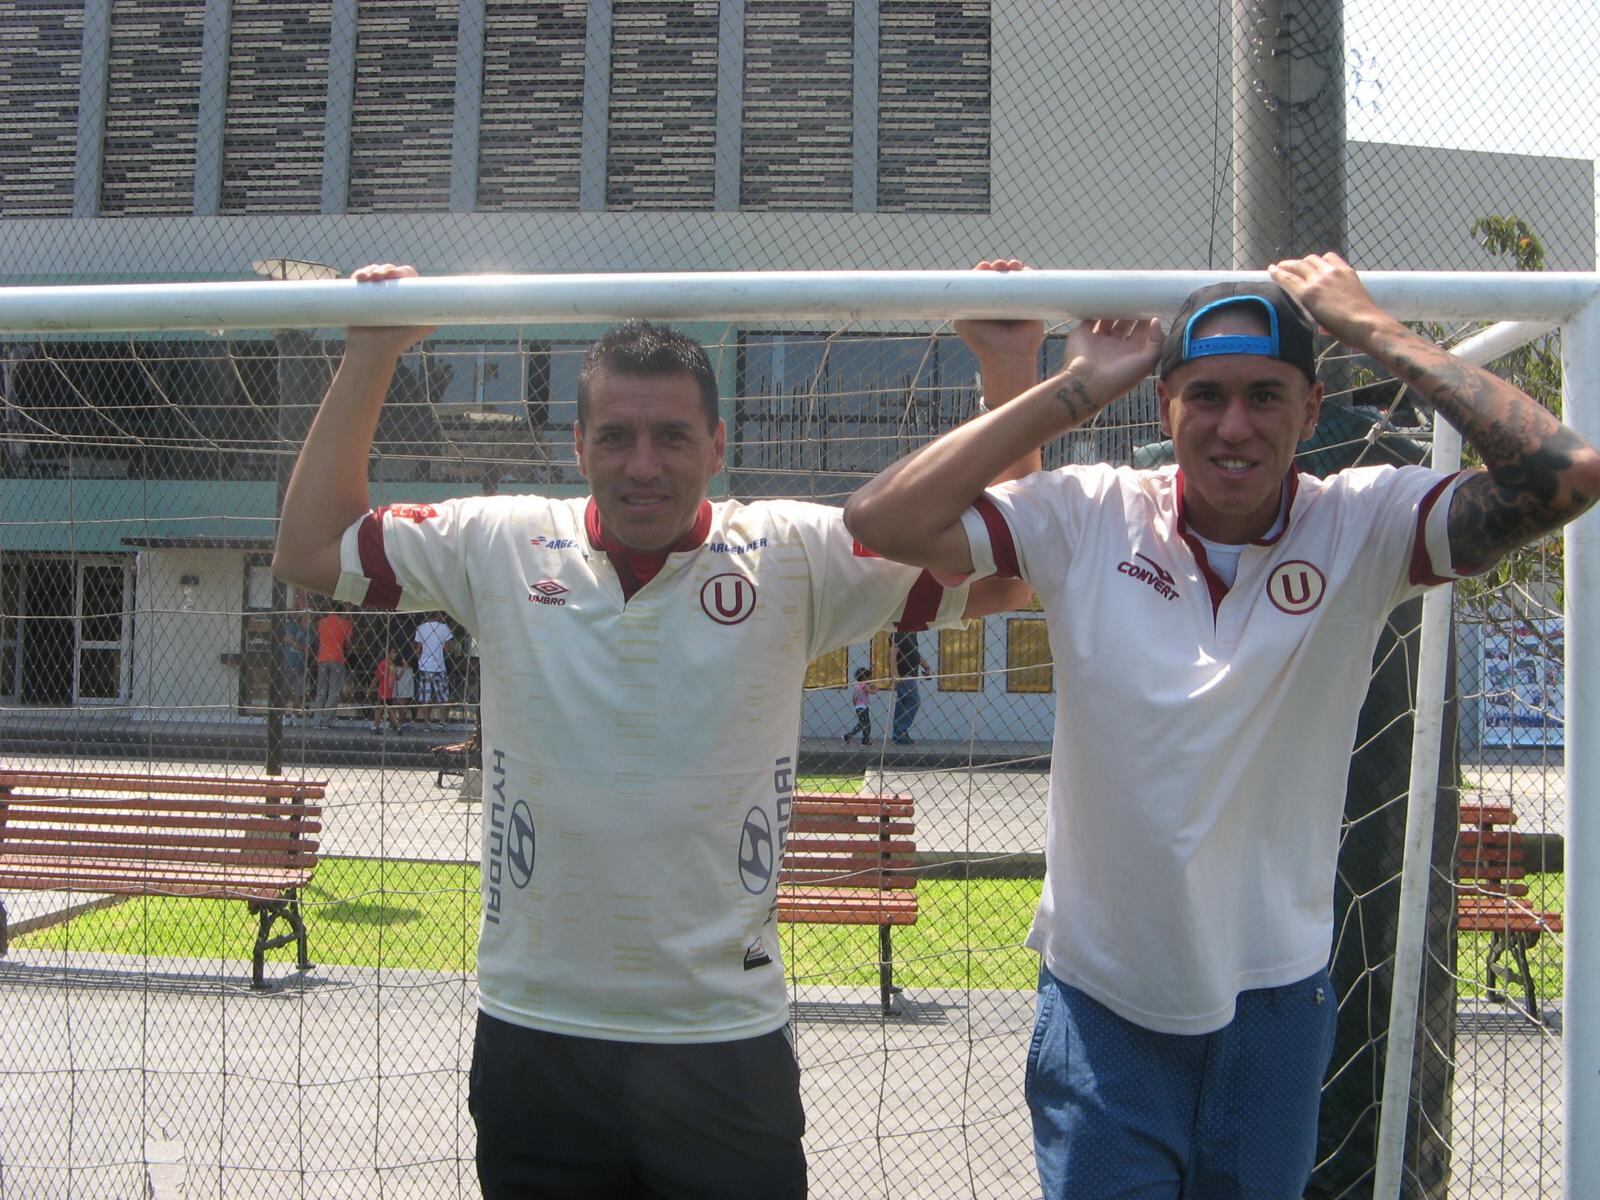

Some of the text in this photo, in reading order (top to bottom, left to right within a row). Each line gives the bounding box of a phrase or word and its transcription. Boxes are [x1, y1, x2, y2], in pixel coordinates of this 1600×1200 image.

[714, 581, 743, 618] U
[1117, 561, 1180, 601] CONVERT
[1281, 571, 1311, 605] U
[528, 594, 566, 606] UMBRO
[486, 748, 506, 925] HYUNDAI
